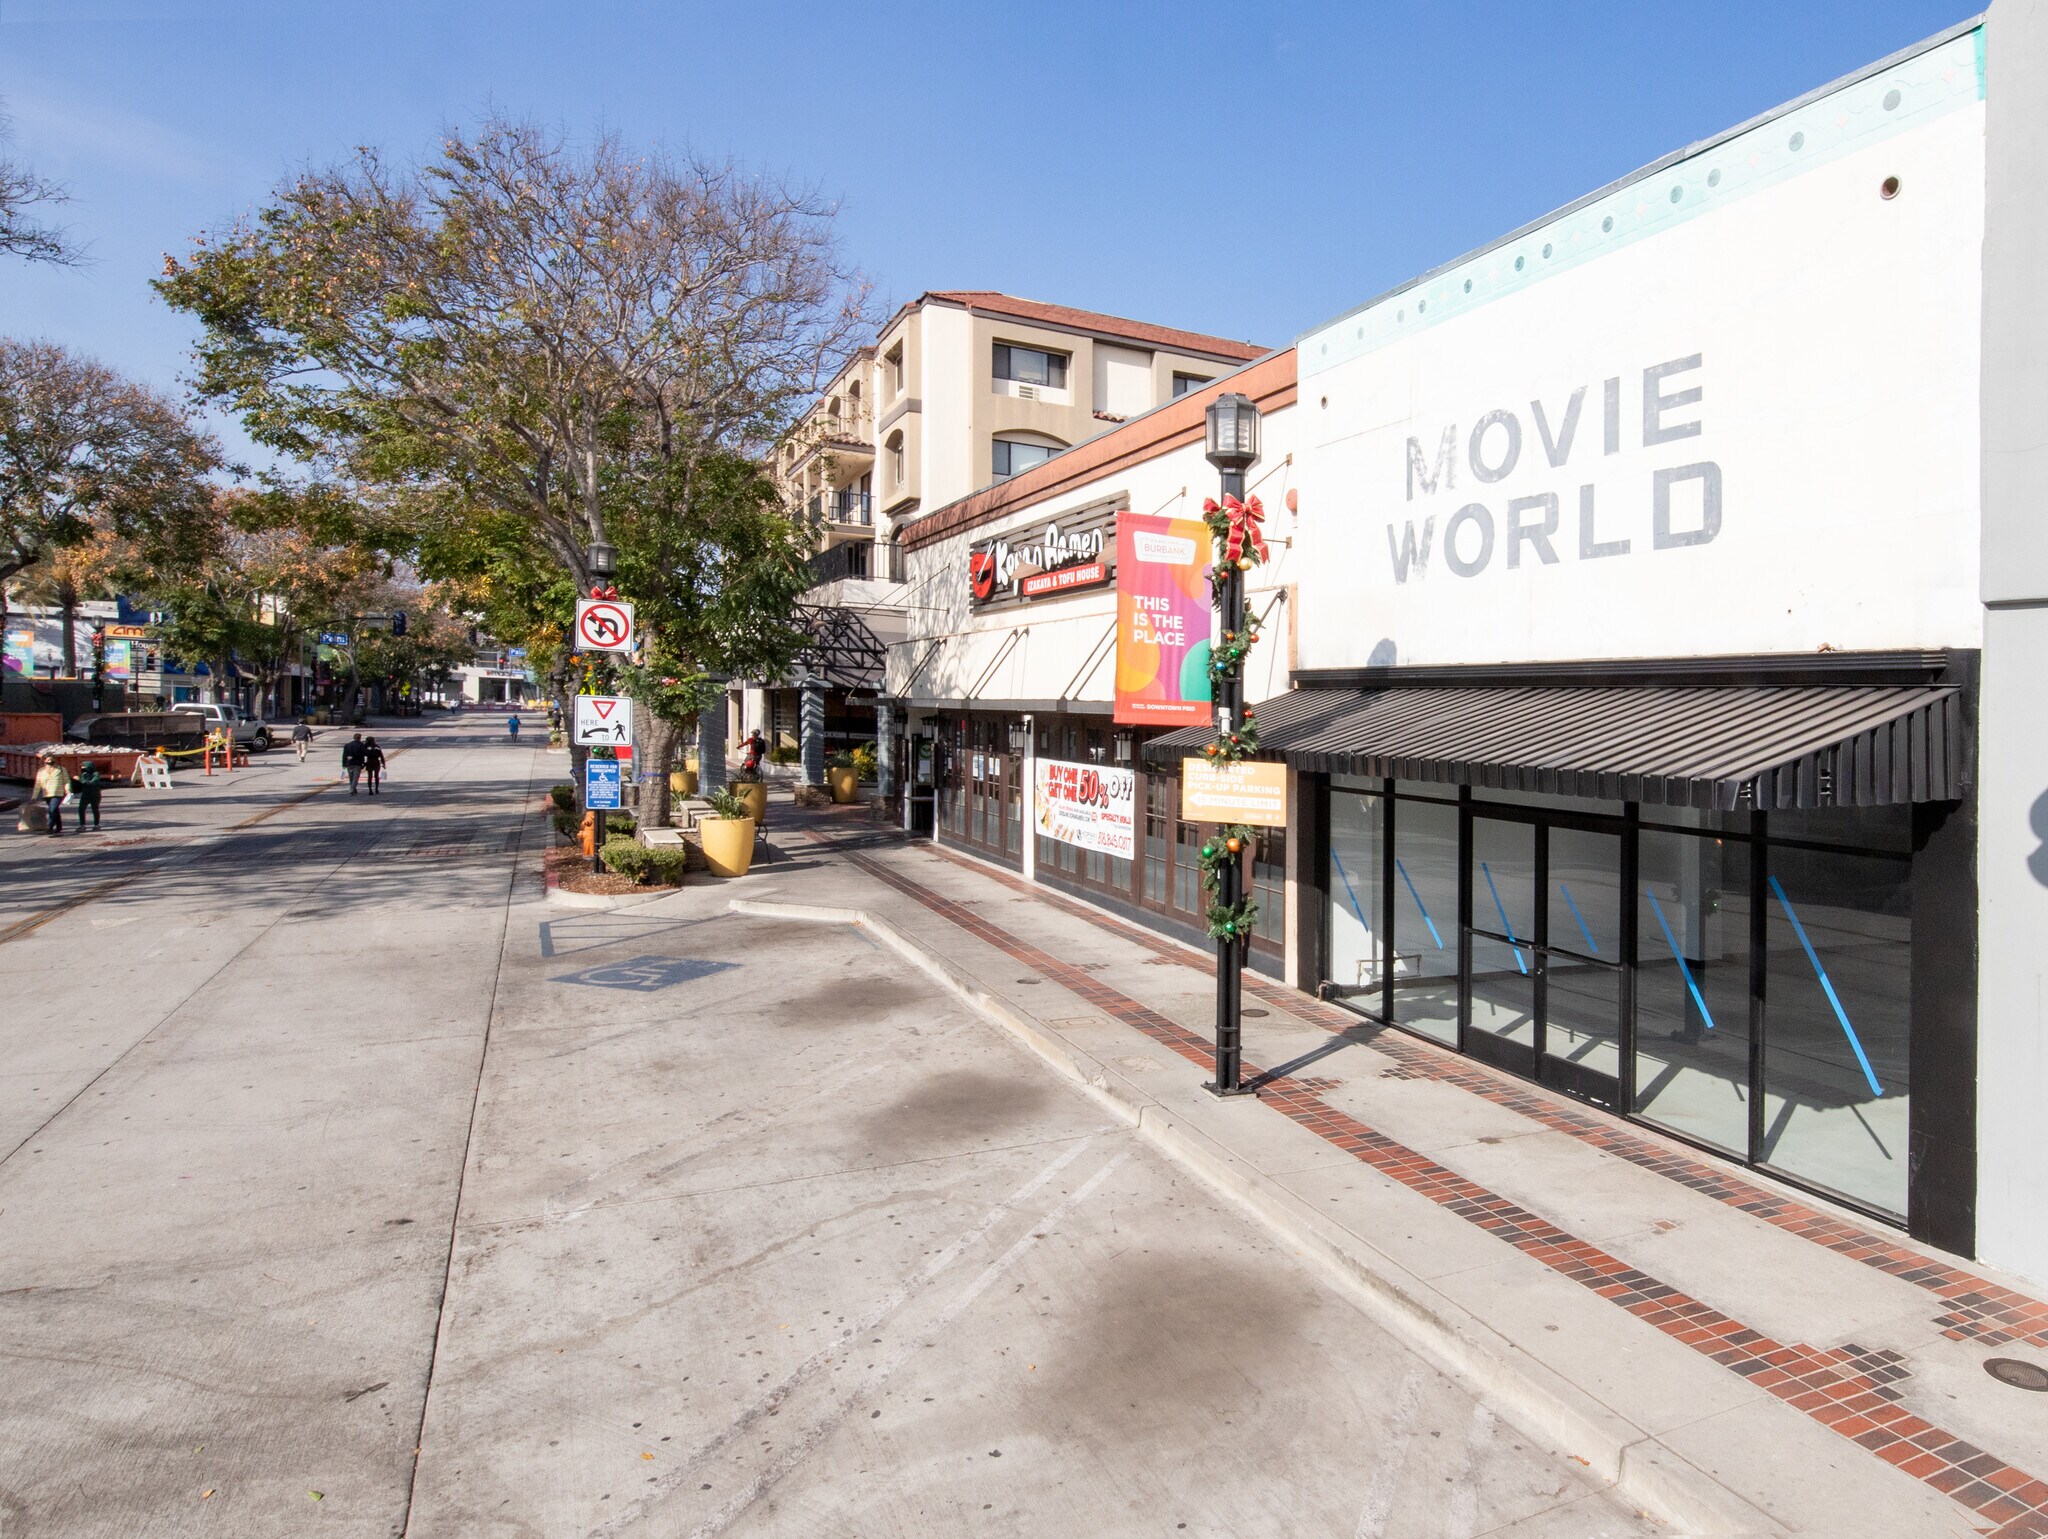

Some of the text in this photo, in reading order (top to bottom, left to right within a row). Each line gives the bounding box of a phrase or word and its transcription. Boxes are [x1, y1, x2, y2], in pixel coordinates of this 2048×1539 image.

[1406, 352, 1702, 501] MOVIE
[1387, 460, 1722, 585] WORLD
[1044, 523, 1103, 571] Ramen
[1144, 543, 1186, 556] BURBANK
[1027, 565, 1100, 592] IZAKAYA & TOFU HOUSE
[1133, 595, 1170, 611] THIS
[1134, 613, 1184, 630] IS THE
[1133, 629, 1185, 646] PLACE
[1146, 703, 1181, 712] DOWNTOWN
[601, 734, 610, 742] TO
[1048, 781, 1078, 803] GET ONE
[1049, 764, 1064, 782] BUY
[1063, 766, 1078, 785] ONE
[1079, 769, 1109, 810] 50%
[1187, 781, 1281, 795] PICK-UP PARKING
[1209, 796, 1248, 806] MINUTE
[1250, 799, 1278, 808] LIMIT
